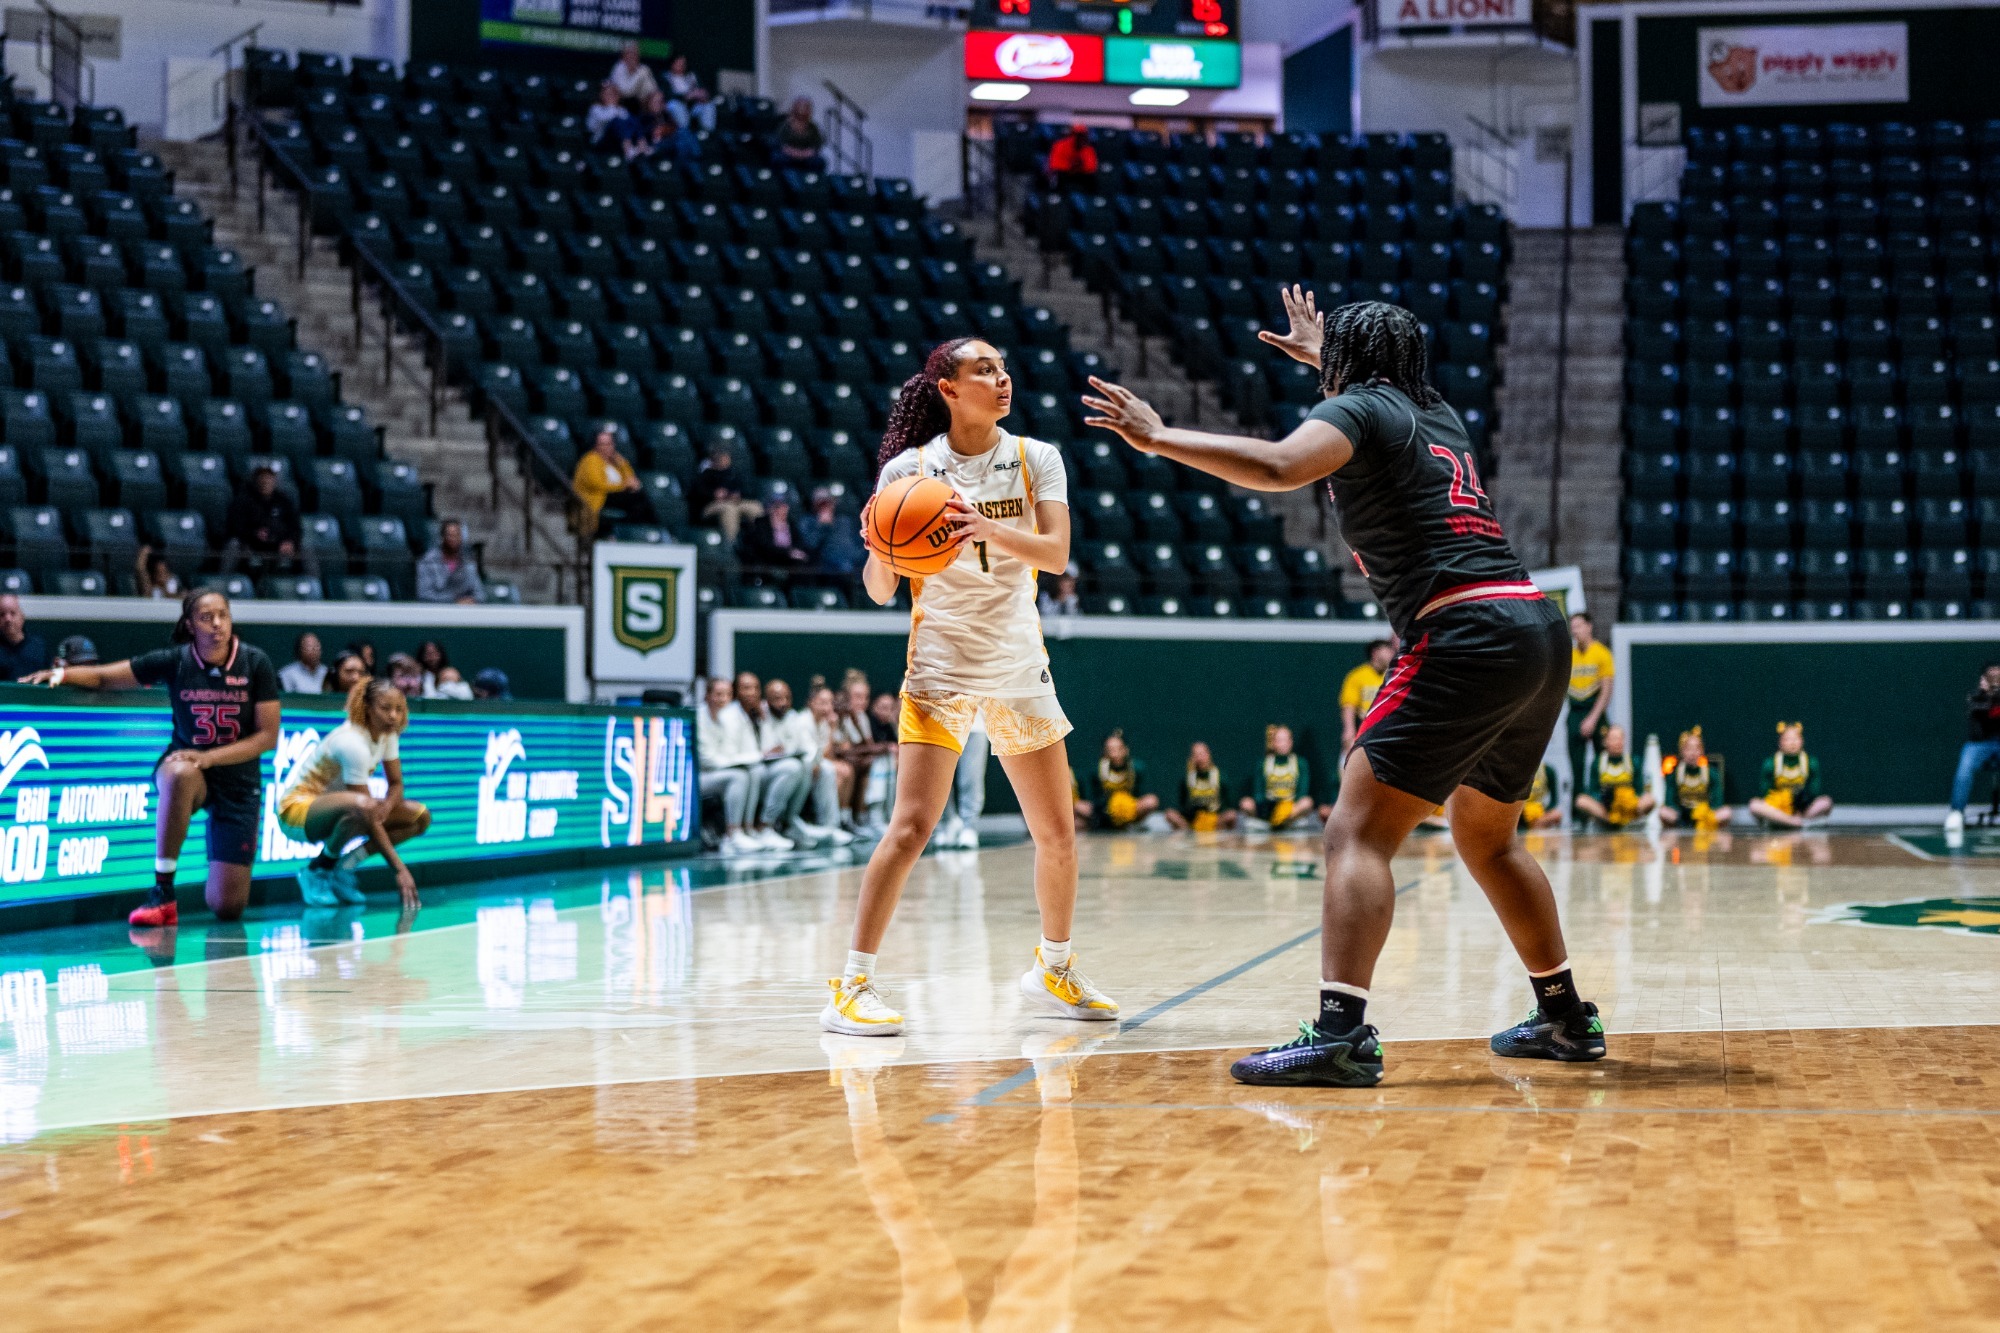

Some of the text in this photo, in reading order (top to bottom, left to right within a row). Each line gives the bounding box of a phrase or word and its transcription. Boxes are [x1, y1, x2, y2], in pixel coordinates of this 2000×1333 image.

[625, 582, 663, 632] S
[191, 704, 241, 744] 35
[15, 784, 150, 823] Bill AUTOMOTIVE
[0, 825, 49, 882] OD
[57, 836, 109, 875] GROUP
